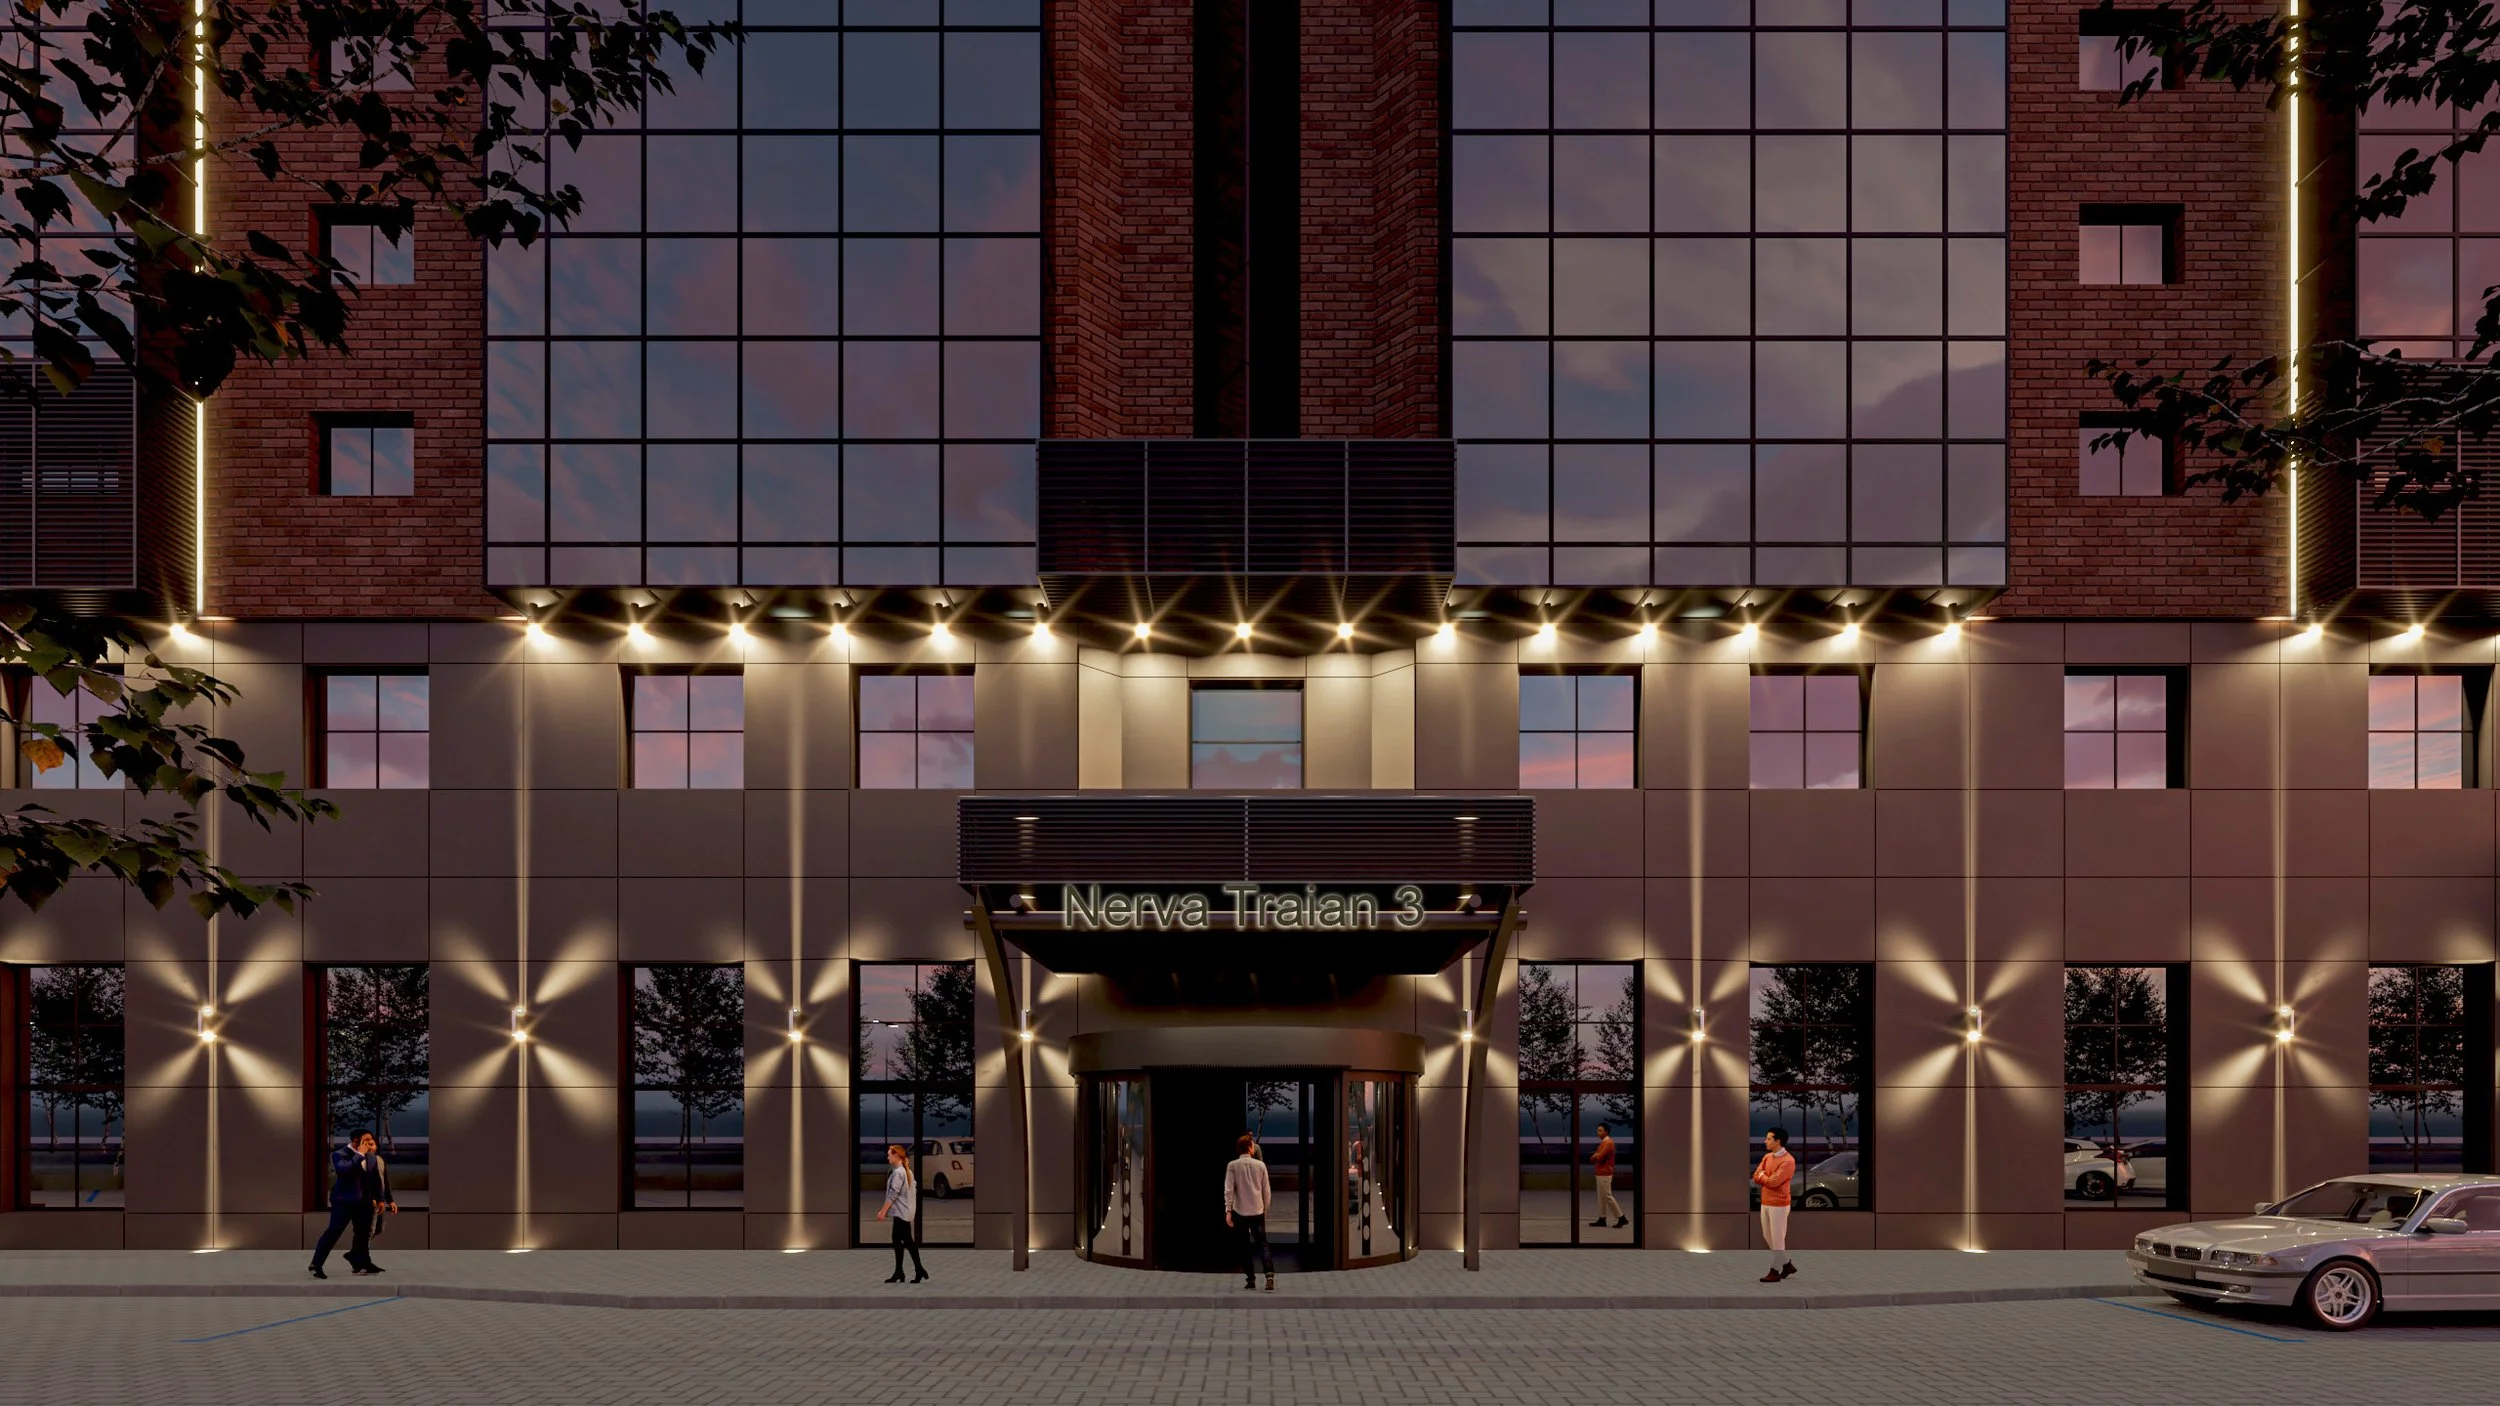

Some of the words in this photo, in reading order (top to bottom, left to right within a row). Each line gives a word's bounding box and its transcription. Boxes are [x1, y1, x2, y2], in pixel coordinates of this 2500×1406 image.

[1063, 884, 1209, 928] Nerva
[1224, 884, 1378, 928] Traian
[1395, 885, 1425, 928] 3
